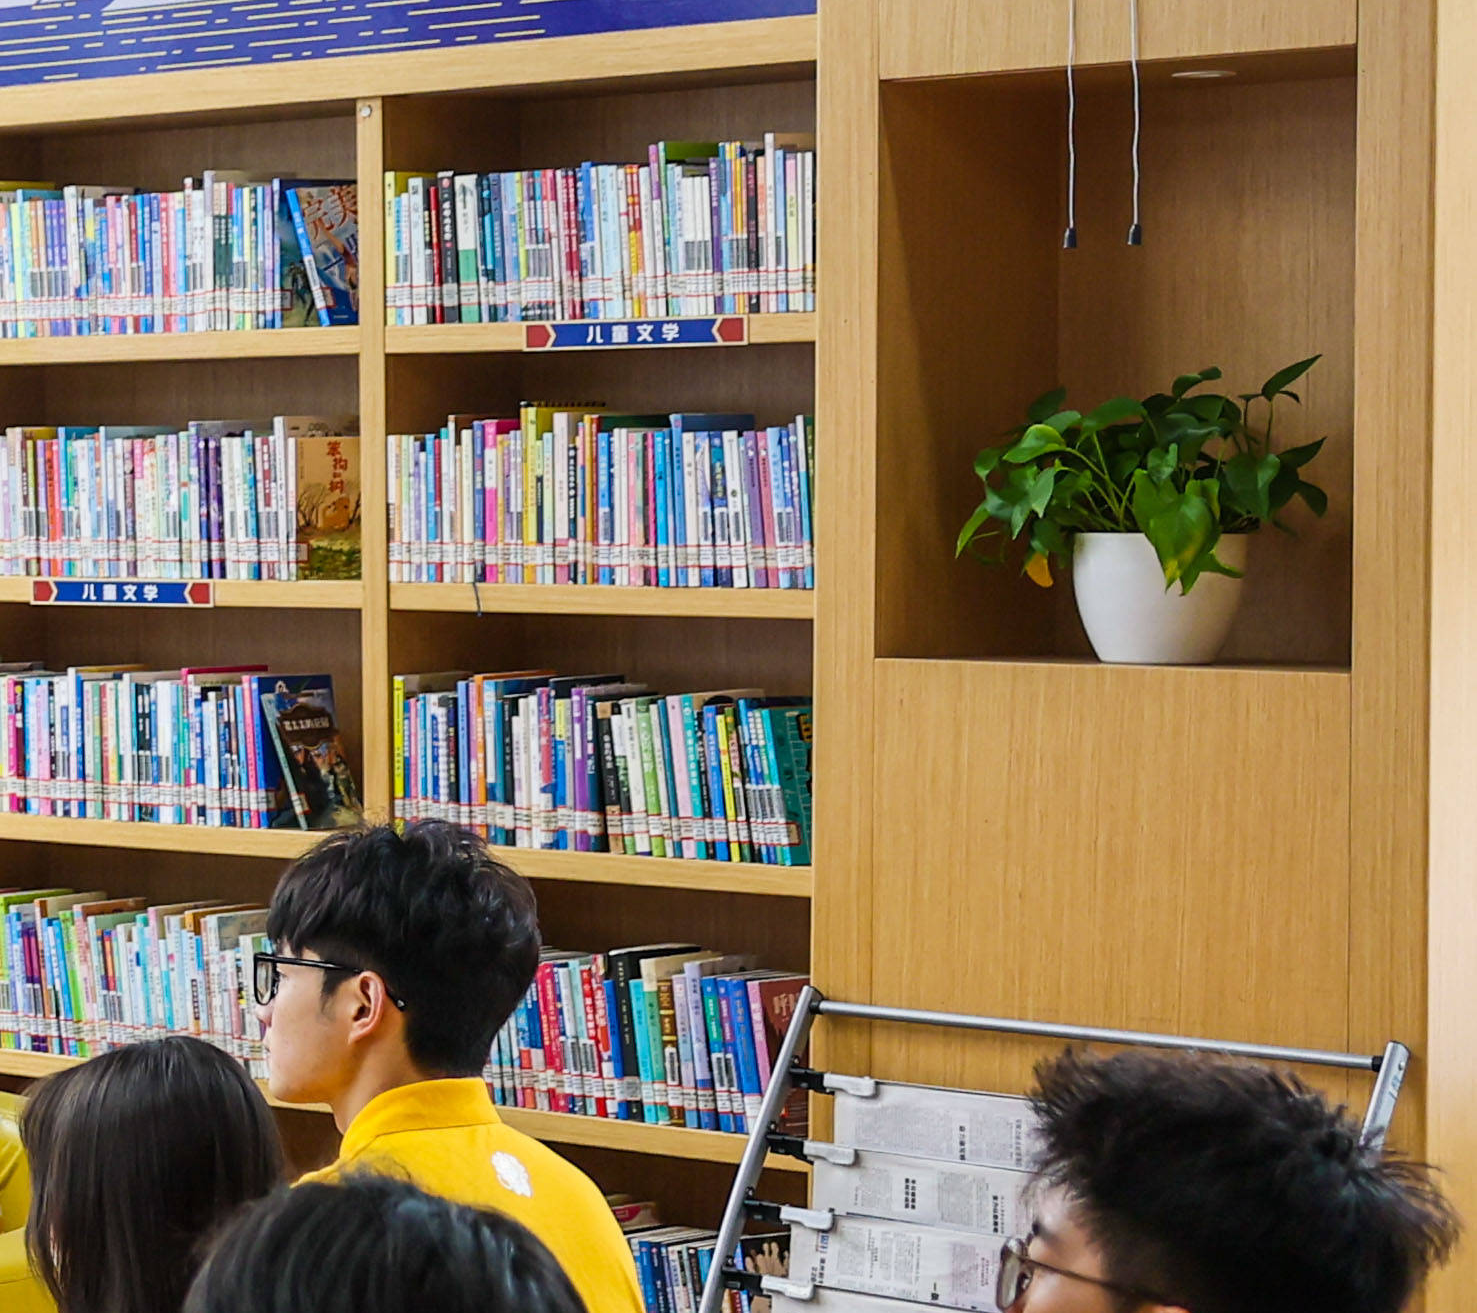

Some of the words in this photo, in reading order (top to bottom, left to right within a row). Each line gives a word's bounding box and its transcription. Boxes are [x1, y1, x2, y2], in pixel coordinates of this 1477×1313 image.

[586, 322, 680, 344] 儿童文学
[81, 584, 160, 602] 儿童文学
